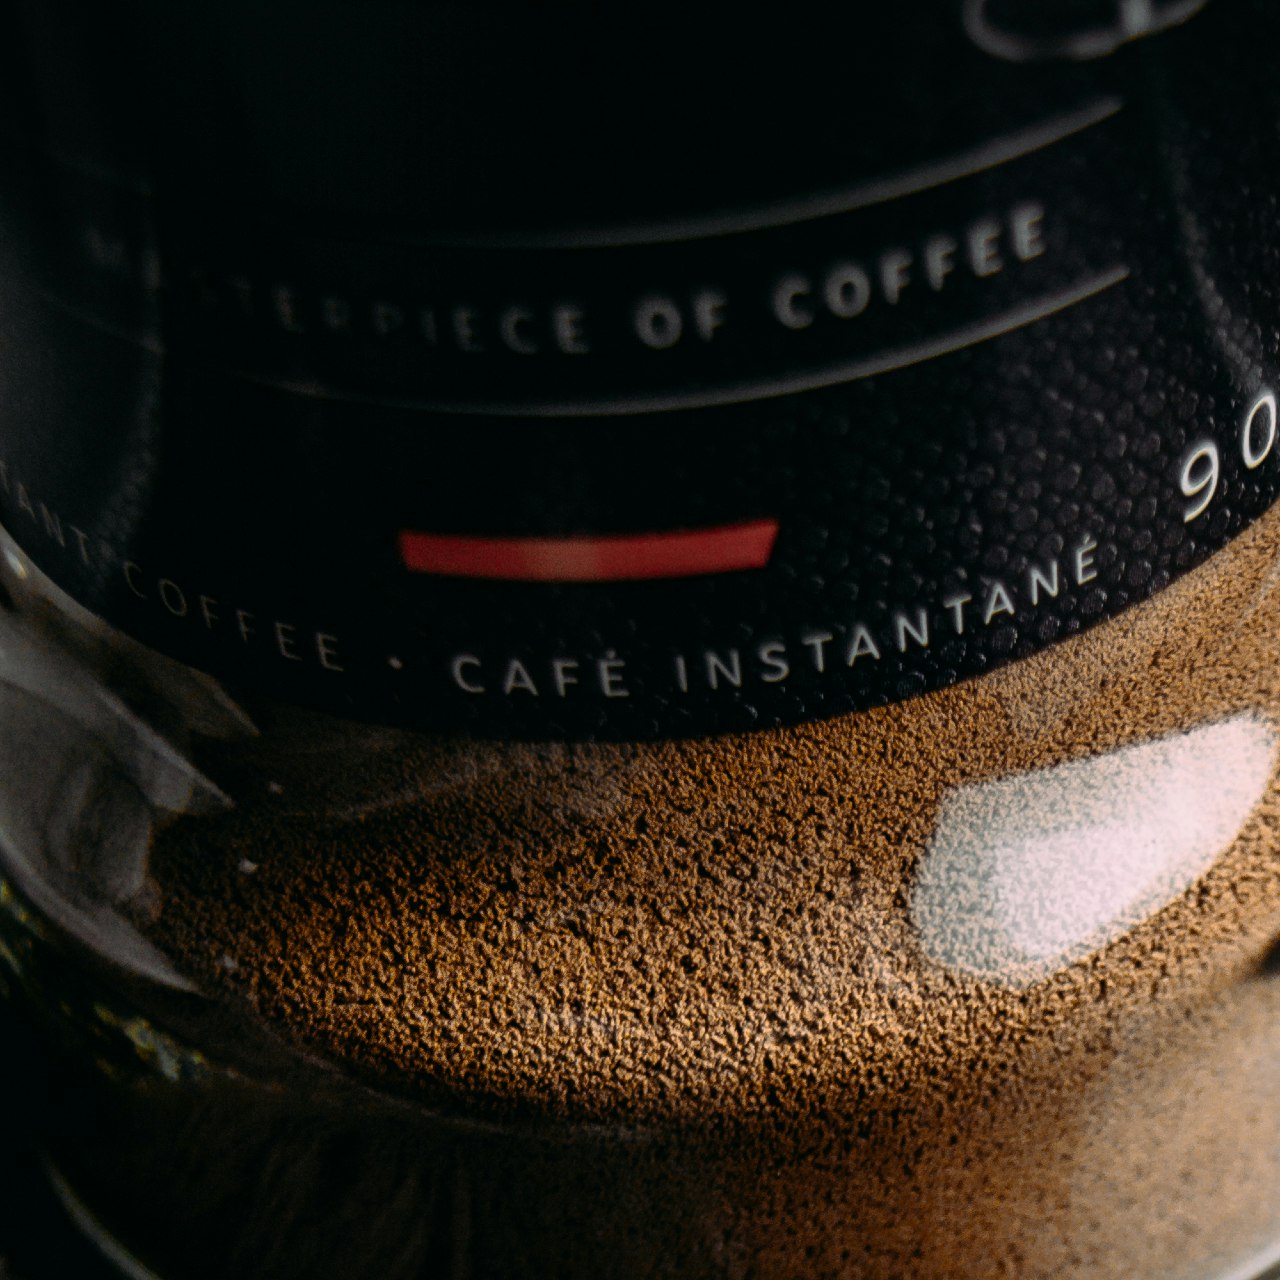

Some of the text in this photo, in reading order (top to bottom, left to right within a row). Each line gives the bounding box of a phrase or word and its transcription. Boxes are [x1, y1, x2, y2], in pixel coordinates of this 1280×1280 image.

[632, 287, 729, 351] OF
[769, 203, 1046, 331] COFFEE
[122, 559, 345, 673] COFFEE
[450, 647, 630, 699] CAFÉ
[674, 538, 1099, 694] INSTANTANÉ
